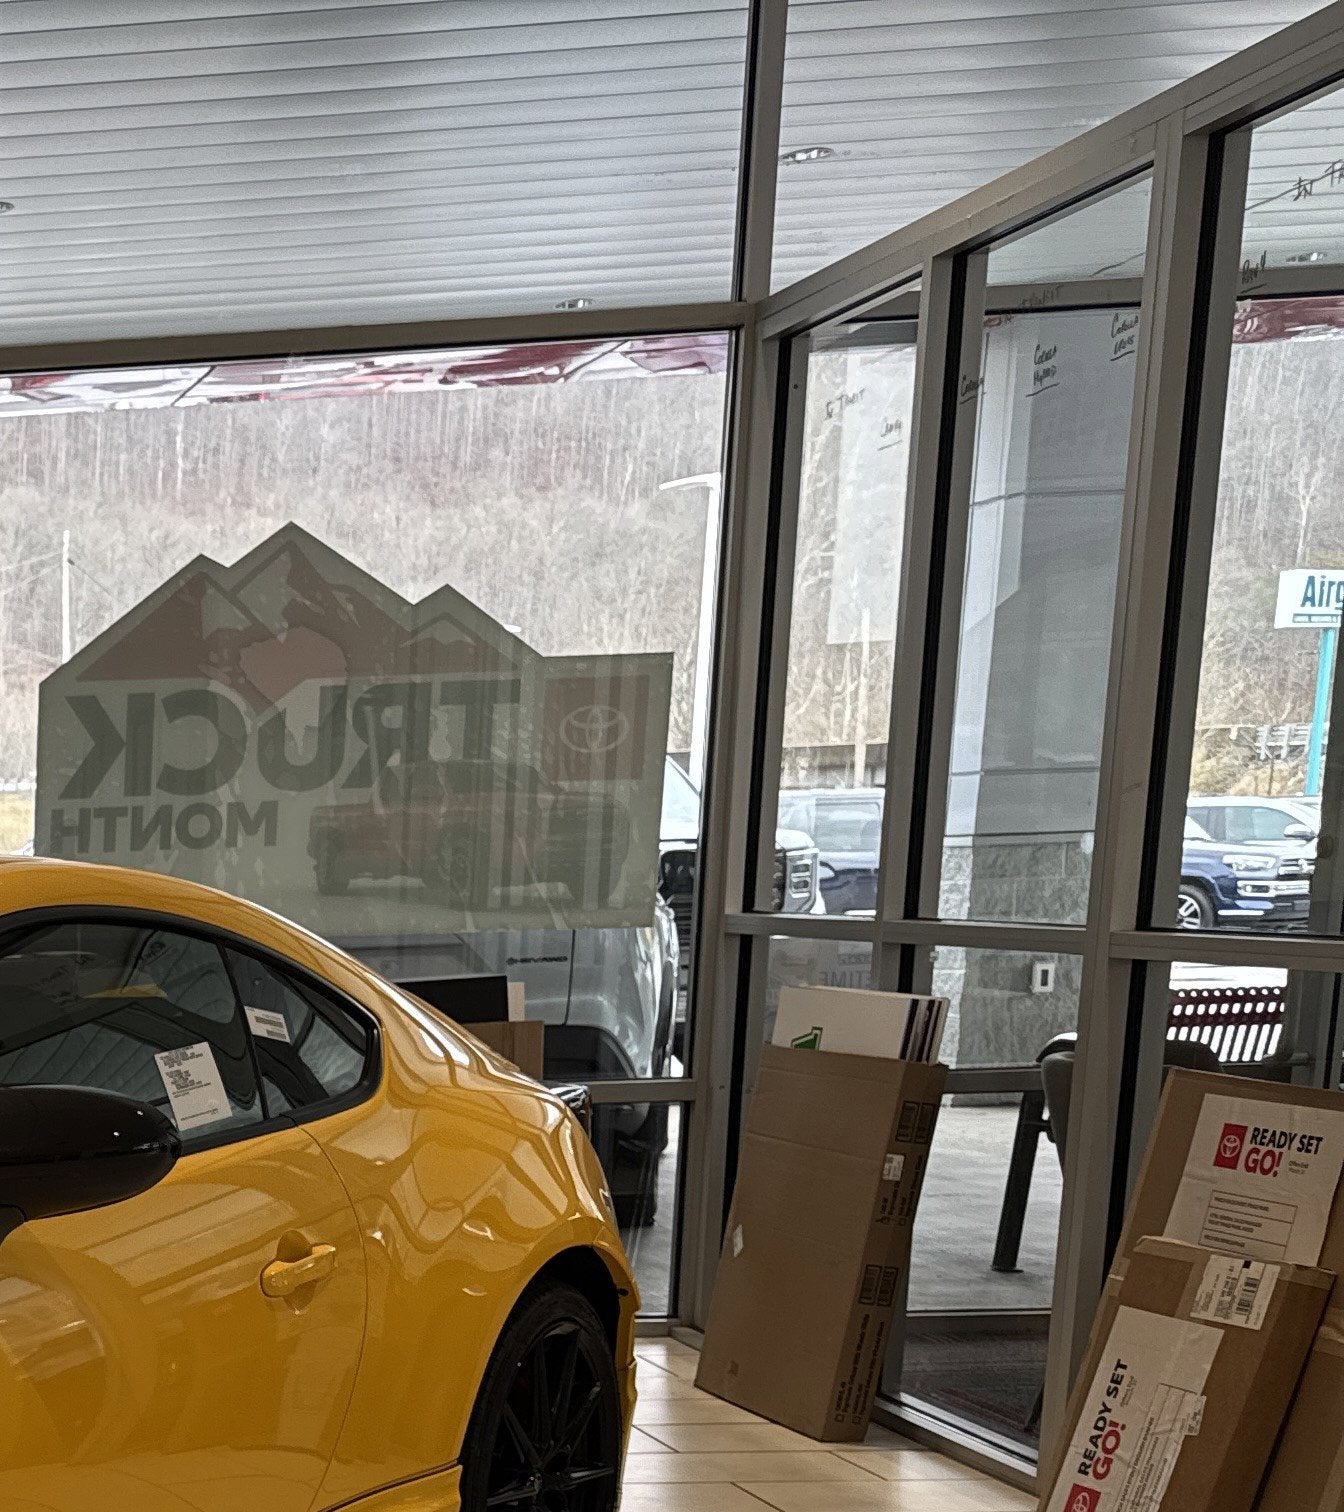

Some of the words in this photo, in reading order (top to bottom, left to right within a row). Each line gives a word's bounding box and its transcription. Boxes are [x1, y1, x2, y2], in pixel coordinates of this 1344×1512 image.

[1244, 1147, 1283, 1178] GO!
[1250, 1127, 1298, 1151] READY
[1296, 1134, 1324, 1155] SET
[1078, 1402, 1112, 1476] READY
[1106, 1358, 1128, 1399] SET
[1092, 1420, 1126, 1480] GO!
